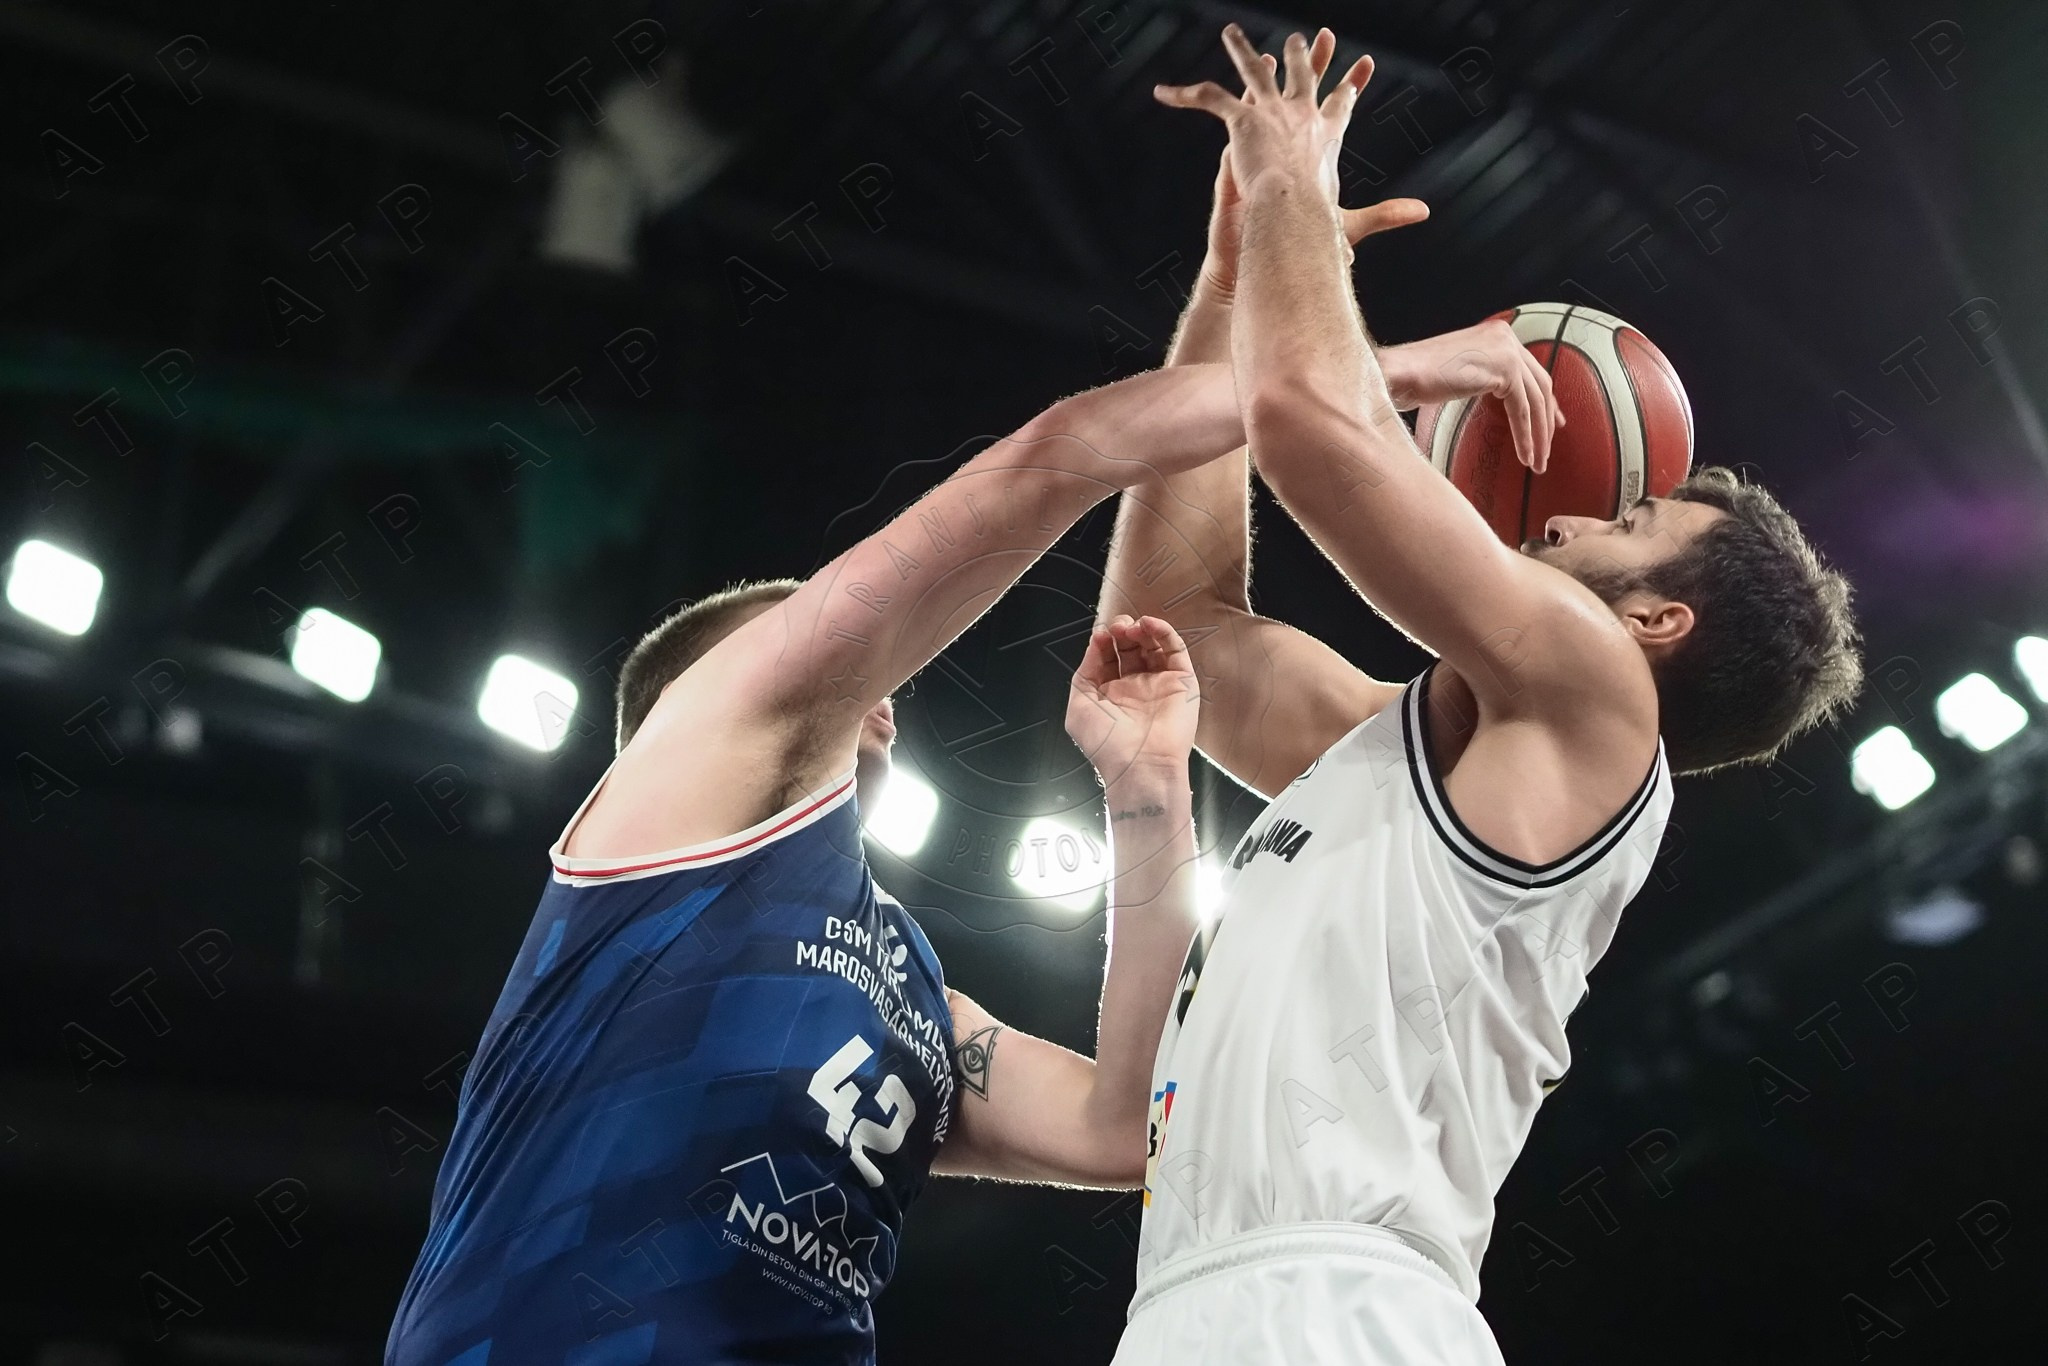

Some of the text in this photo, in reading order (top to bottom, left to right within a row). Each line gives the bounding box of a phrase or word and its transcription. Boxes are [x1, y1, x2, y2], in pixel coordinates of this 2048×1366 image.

[825, 916, 872, 956] CSM
[807, 1034, 916, 1188] 42
[751, 1242, 768, 1258] DIN
